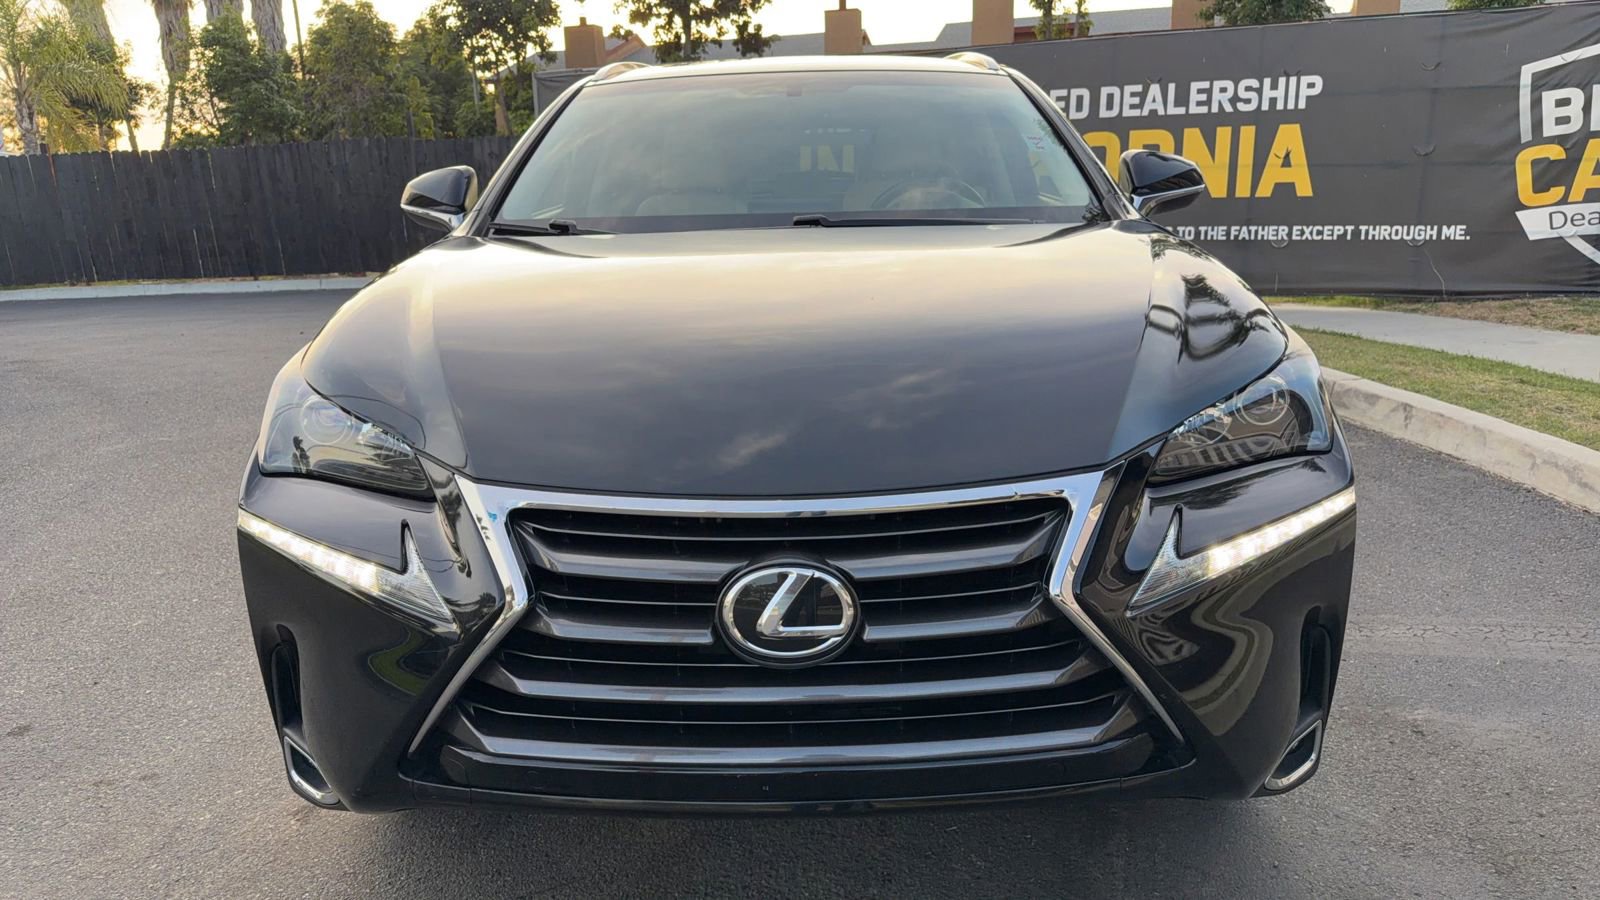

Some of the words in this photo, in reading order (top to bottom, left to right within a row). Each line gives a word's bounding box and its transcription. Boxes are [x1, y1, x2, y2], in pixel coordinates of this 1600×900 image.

[1099, 75, 1323, 118] DEALERSHIP
[1177, 226, 1195, 240] TO
[1199, 226, 1227, 240] THE
[1230, 226, 1289, 240] FATHER
[1292, 225, 1355, 240] EXCEPT
[1359, 225, 1438, 240] THROUGH
[1441, 225, 1471, 240] ME.
